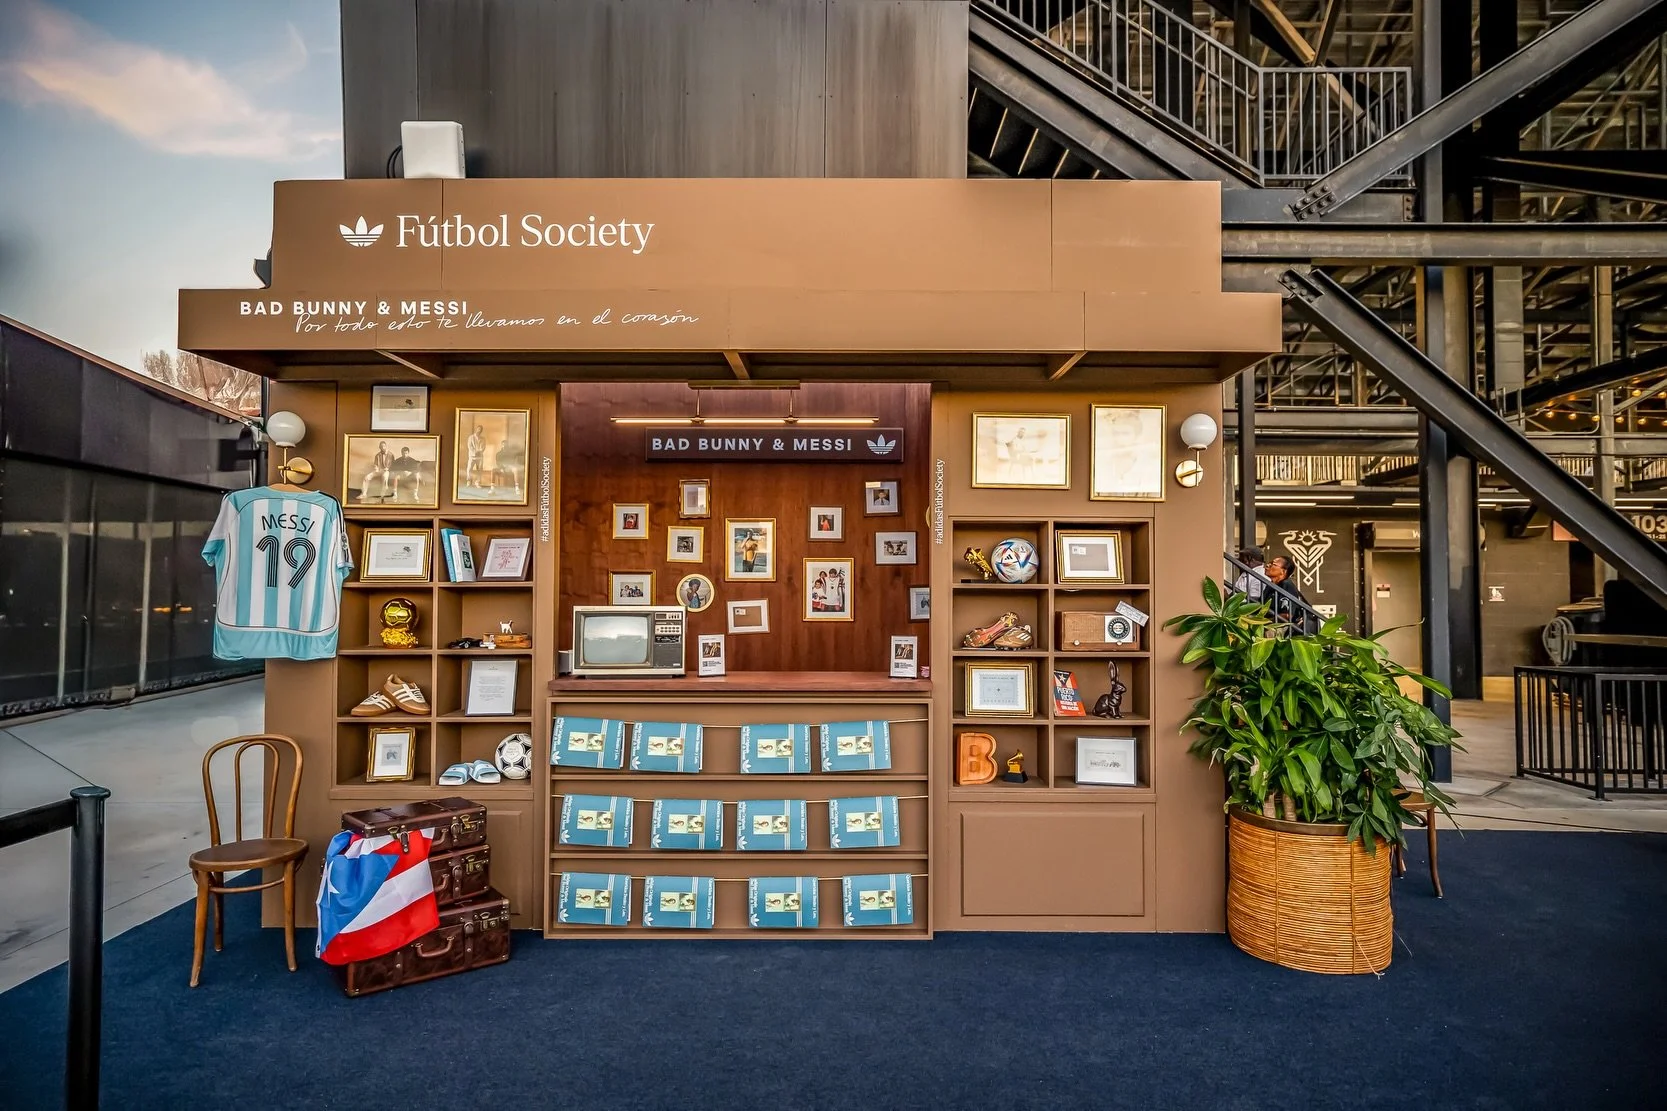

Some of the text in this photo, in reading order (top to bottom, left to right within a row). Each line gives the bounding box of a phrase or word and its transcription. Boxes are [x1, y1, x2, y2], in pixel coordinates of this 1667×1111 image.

[396, 214, 656, 255] Fútbol Society
[240, 301, 467, 315] BAD BUNNY & MESSI
[295, 312, 327, 333] Por
[334, 317, 378, 333] todo
[388, 314, 431, 330] esto
[437, 315, 458, 328] te
[465, 311, 545, 328] llevamos
[557, 314, 581, 325] en
[592, 308, 612, 325] el
[652, 438, 852, 451] BAD BUNNY & MESSI
[541, 456, 551, 542] #adidasFútbolSociety
[935, 458, 945, 545] #adidasFútbolSociety
[261, 513, 315, 535] MESSI
[256, 535, 316, 589] 19
